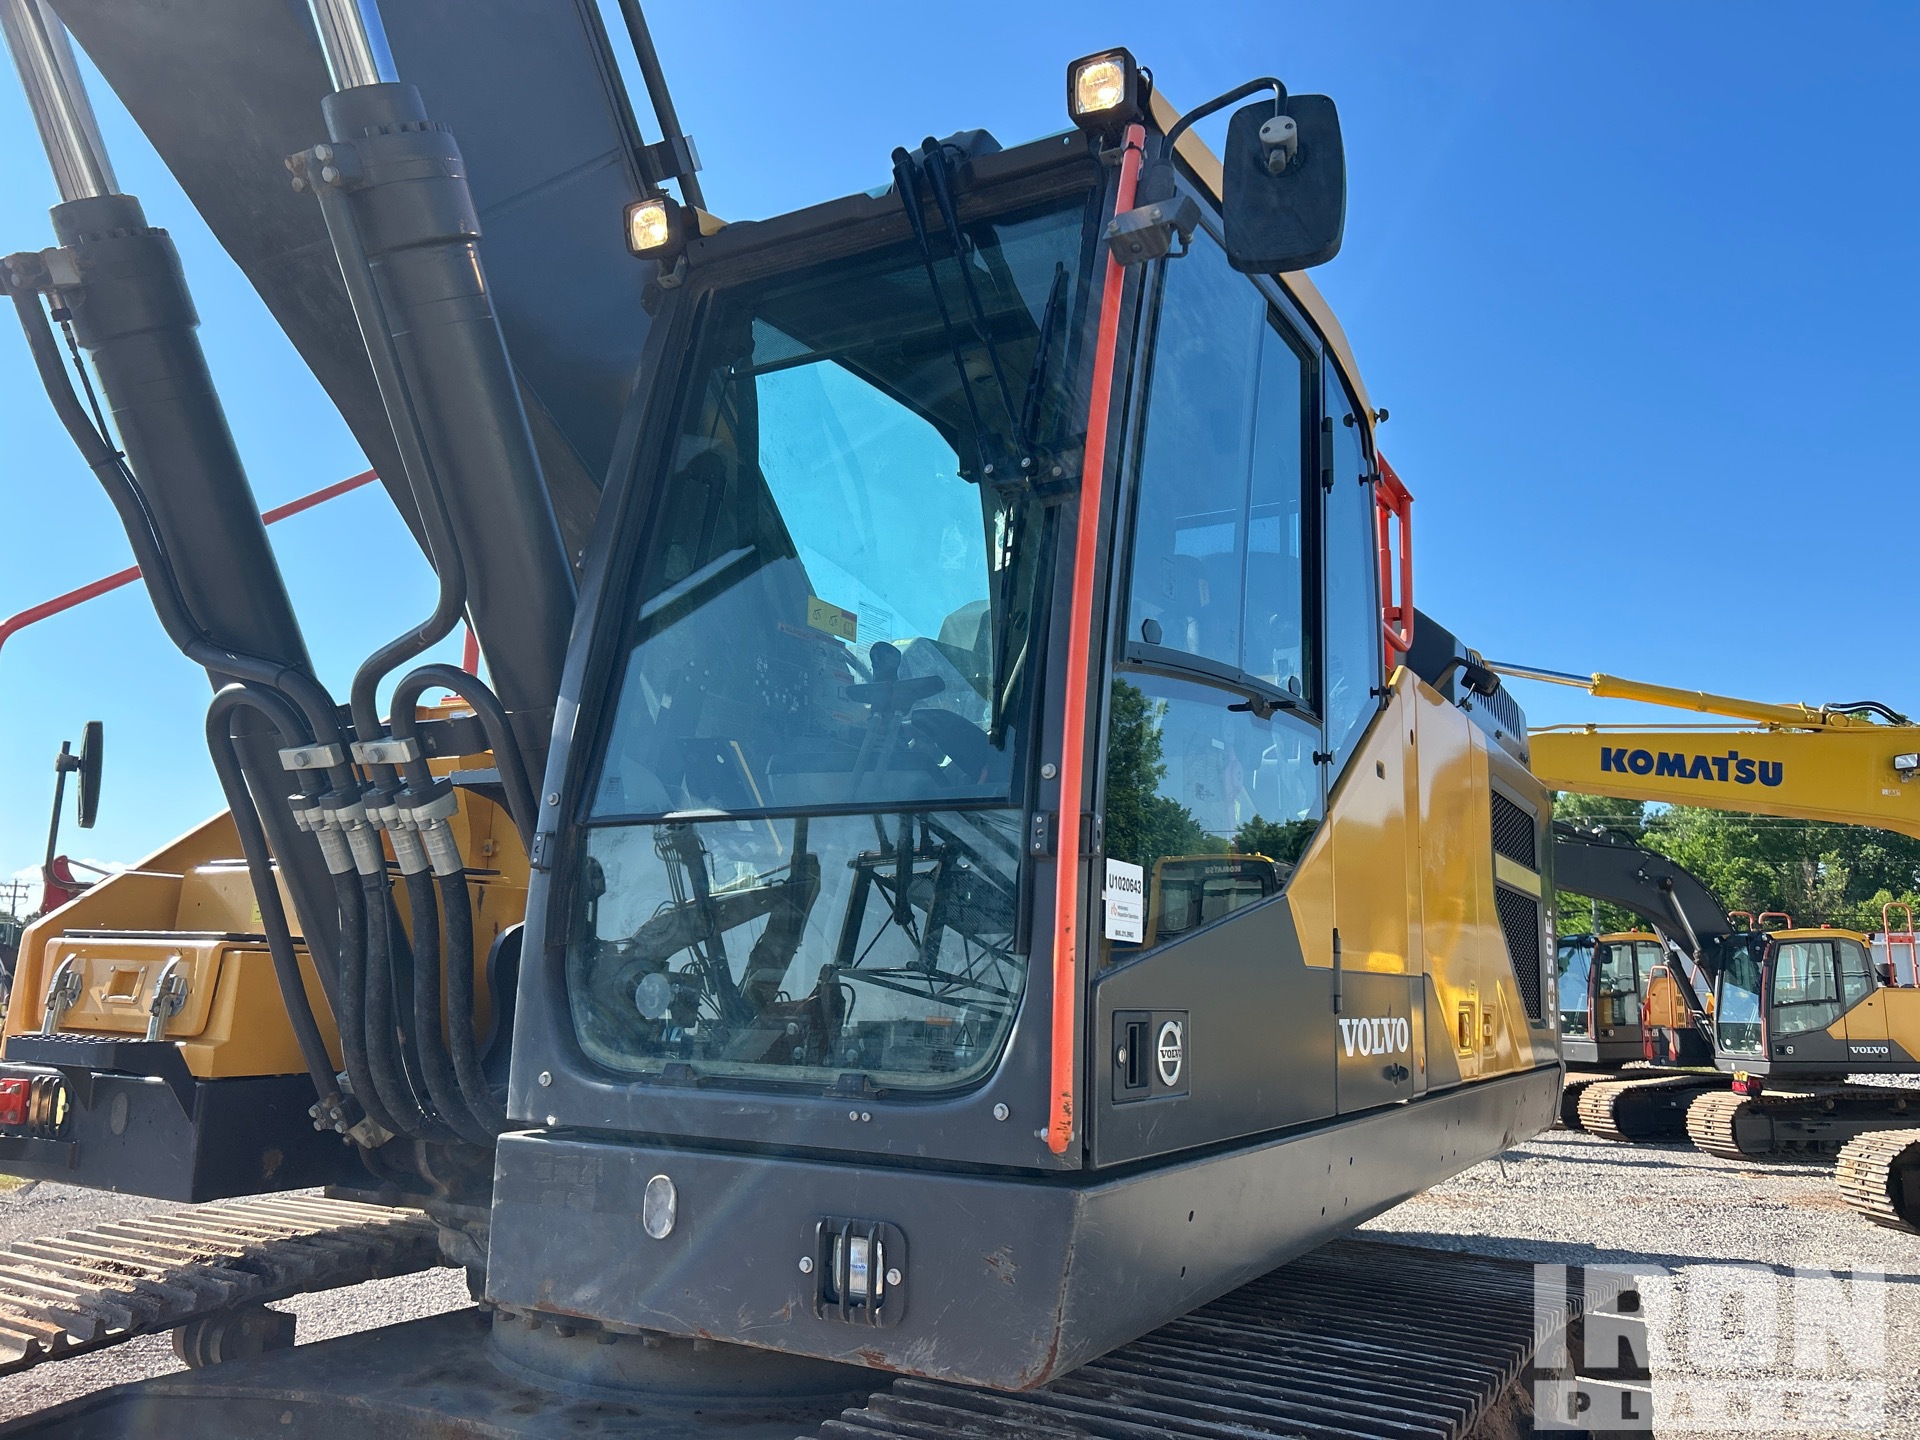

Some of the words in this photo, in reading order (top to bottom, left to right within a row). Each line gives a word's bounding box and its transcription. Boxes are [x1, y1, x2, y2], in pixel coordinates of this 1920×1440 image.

[1601, 747, 1783, 787] KOMATSU
[1109, 873, 1142, 895] U1020643
[1339, 1017, 1409, 1057] VOLVO
[1850, 1046, 1889, 1054] VOLVO
